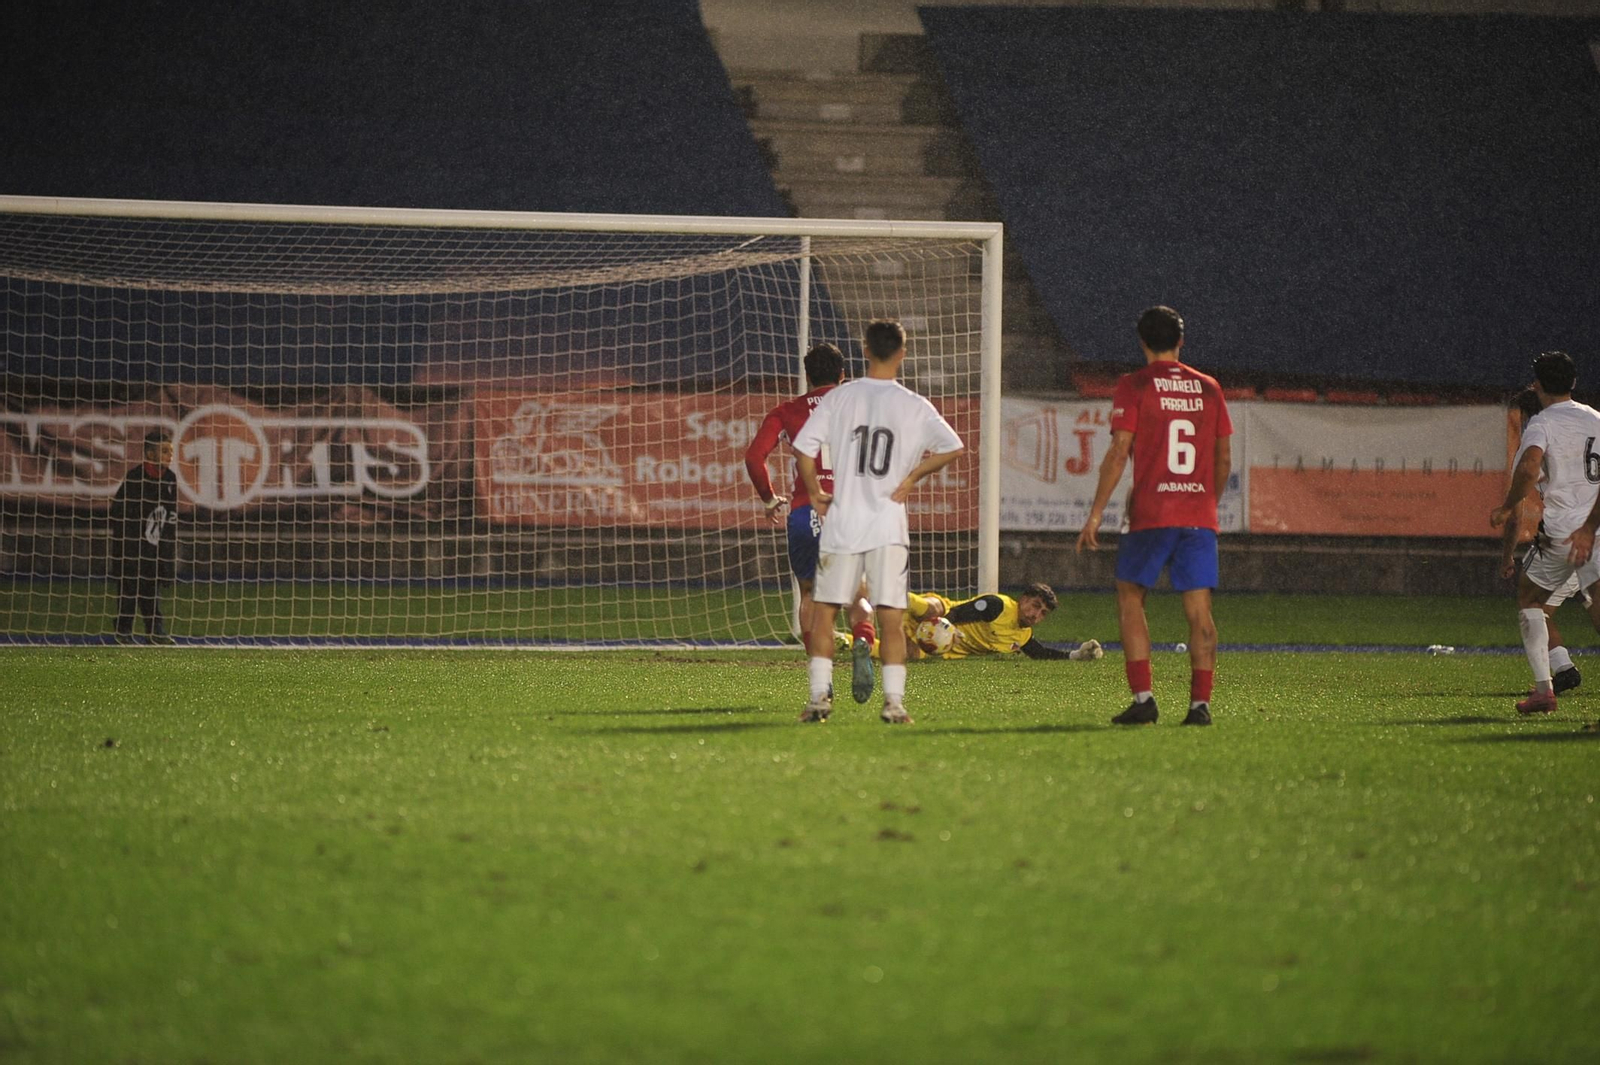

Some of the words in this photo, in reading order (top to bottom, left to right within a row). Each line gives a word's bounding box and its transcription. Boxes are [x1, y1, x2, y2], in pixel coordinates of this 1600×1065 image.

[851, 425, 894, 480] 10
[1167, 419, 1196, 475] 6
[1583, 436, 1600, 484] 6
